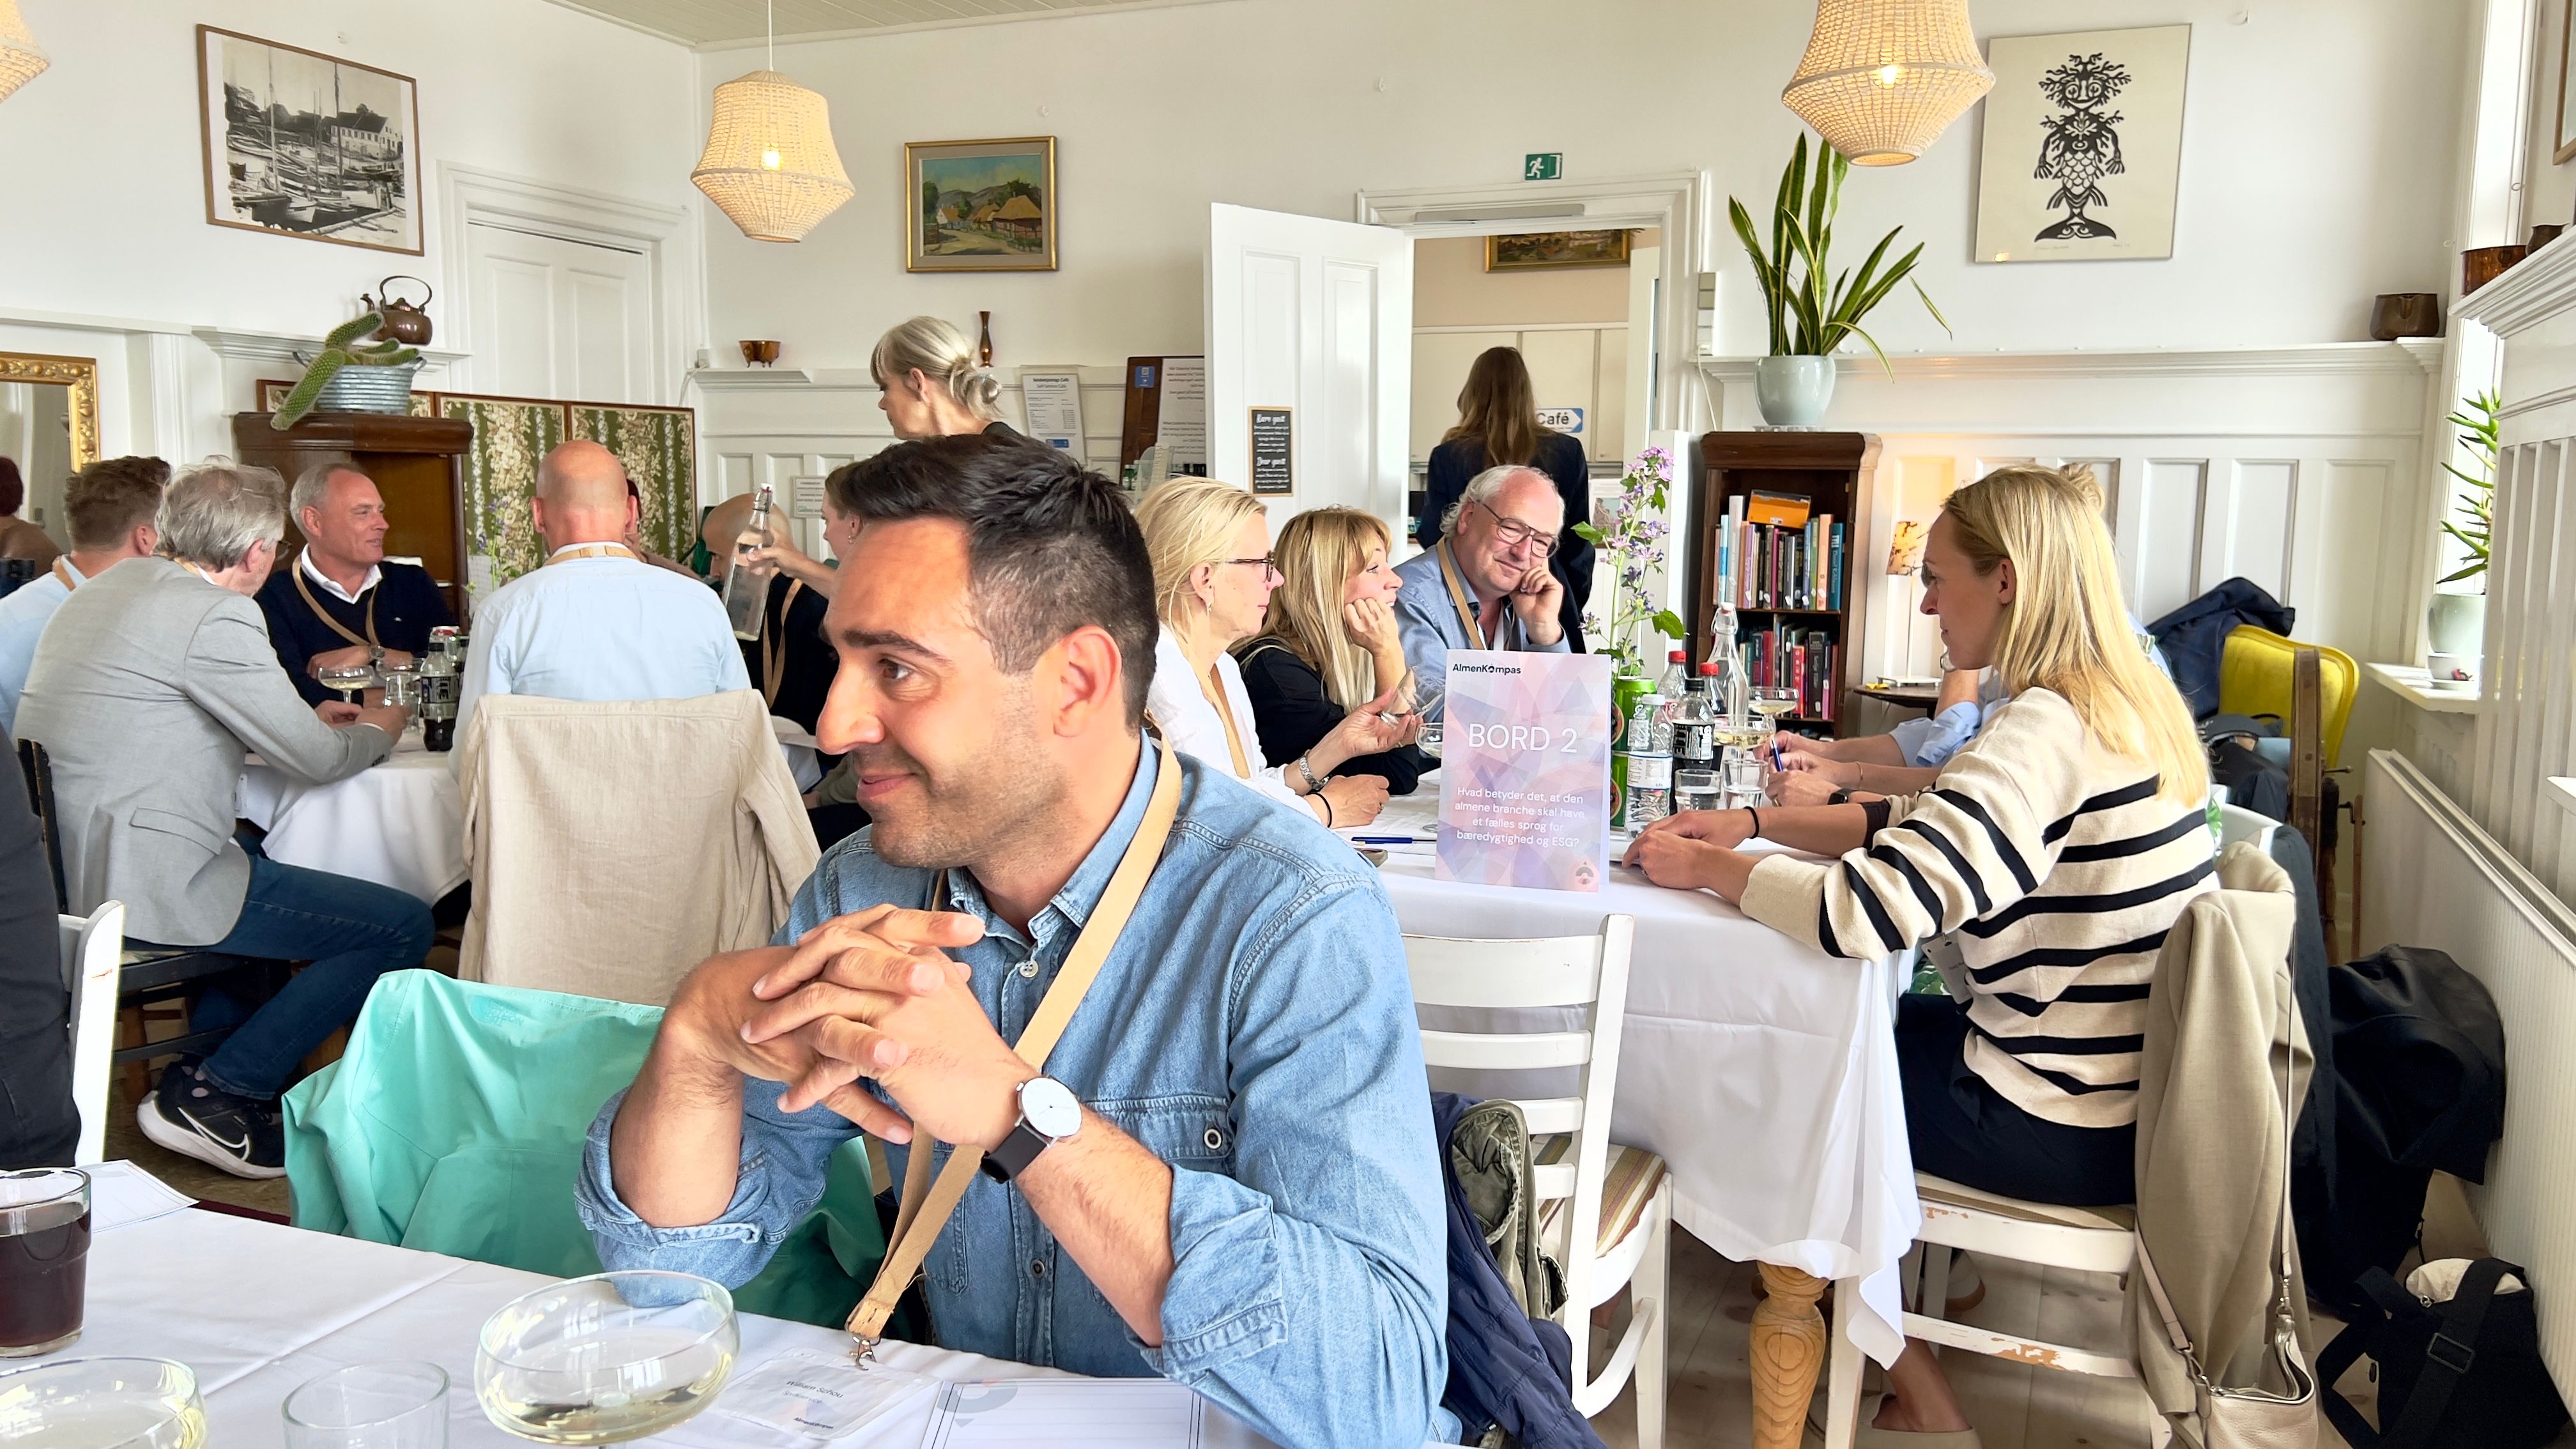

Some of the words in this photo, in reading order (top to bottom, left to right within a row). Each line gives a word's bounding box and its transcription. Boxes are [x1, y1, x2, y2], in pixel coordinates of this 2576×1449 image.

[1537, 412, 1569, 425] Café
[1453, 663, 1521, 675] AlmenKompas
[1469, 723, 1551, 751] BORD
[1560, 728, 1578, 753] 2
[1457, 786, 1482, 797] Hvad
[1485, 788, 1524, 801] betyder
[1527, 792, 1547, 802] det,
[1549, 794, 1560, 802] at
[1563, 793, 1583, 804] den
[1455, 801, 1491, 812] almene
[1492, 803, 1535, 815] branche
[1537, 807, 1558, 817] skal
[1560, 808, 1585, 818] have
[1472, 818, 1483, 826] et
[1485, 818, 1515, 829] fælles
[1517, 822, 1547, 833] sprog
[1549, 822, 1565, 831] for
[1457, 830, 1534, 846] bæredygtighed
[1536, 838, 1549, 848] og
[1552, 836, 1580, 847] ESG?
